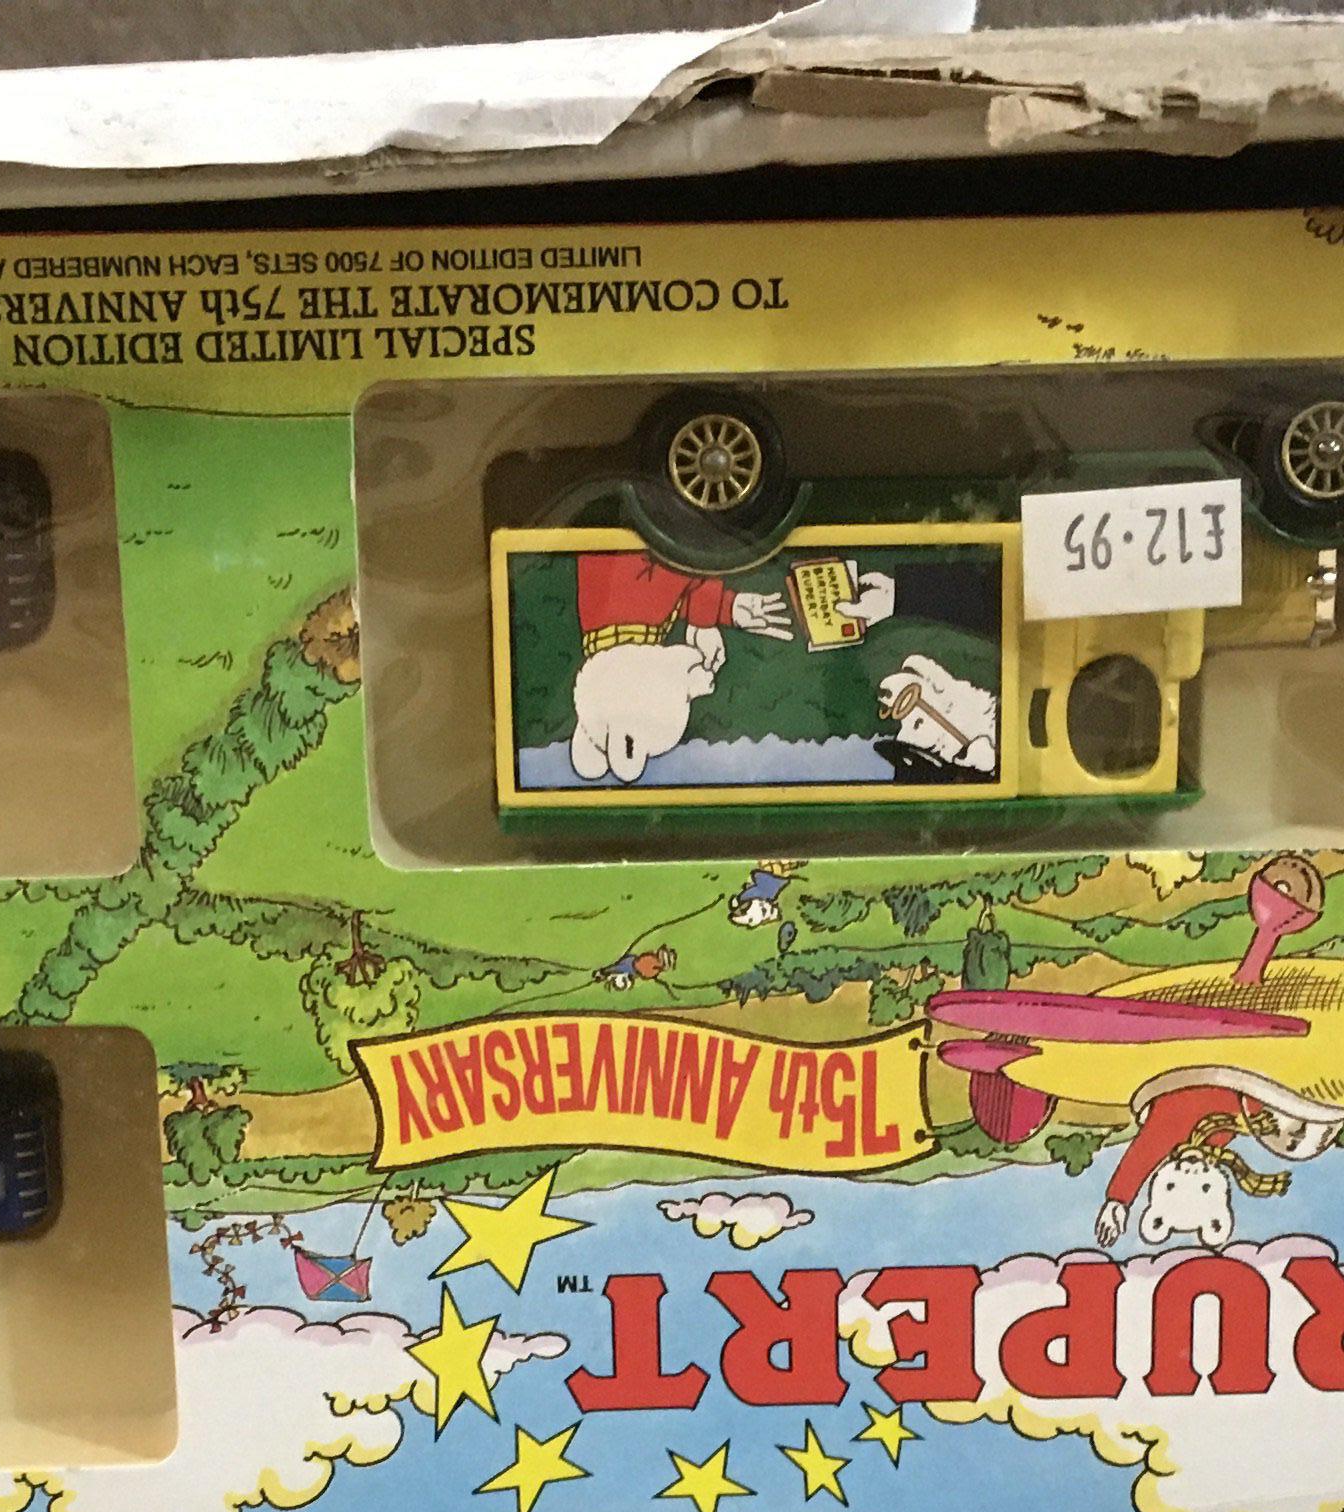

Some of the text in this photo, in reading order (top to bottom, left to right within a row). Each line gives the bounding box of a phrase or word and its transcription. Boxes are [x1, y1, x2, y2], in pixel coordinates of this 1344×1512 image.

[13, 255, 161, 279] NUMBERED
[168, 253, 239, 277] EACH
[246, 250, 318, 275] SETS,
[324, 250, 382, 273] 7500
[389, 249, 424, 272] OF
[431, 247, 533, 271] EDITION
[540, 245, 641, 269] LIMITED
[200, 284, 285, 325] 75th
[298, 285, 378, 320] THE
[391, 279, 719, 317] COMMEMORATE
[731, 277, 789, 310] TO
[13, 332, 182, 366] EDITION
[196, 328, 361, 363] LIMITED
[375, 323, 535, 359] SPECIAL
[389, 1022, 901, 1158] 75th ANNIVERSARY
